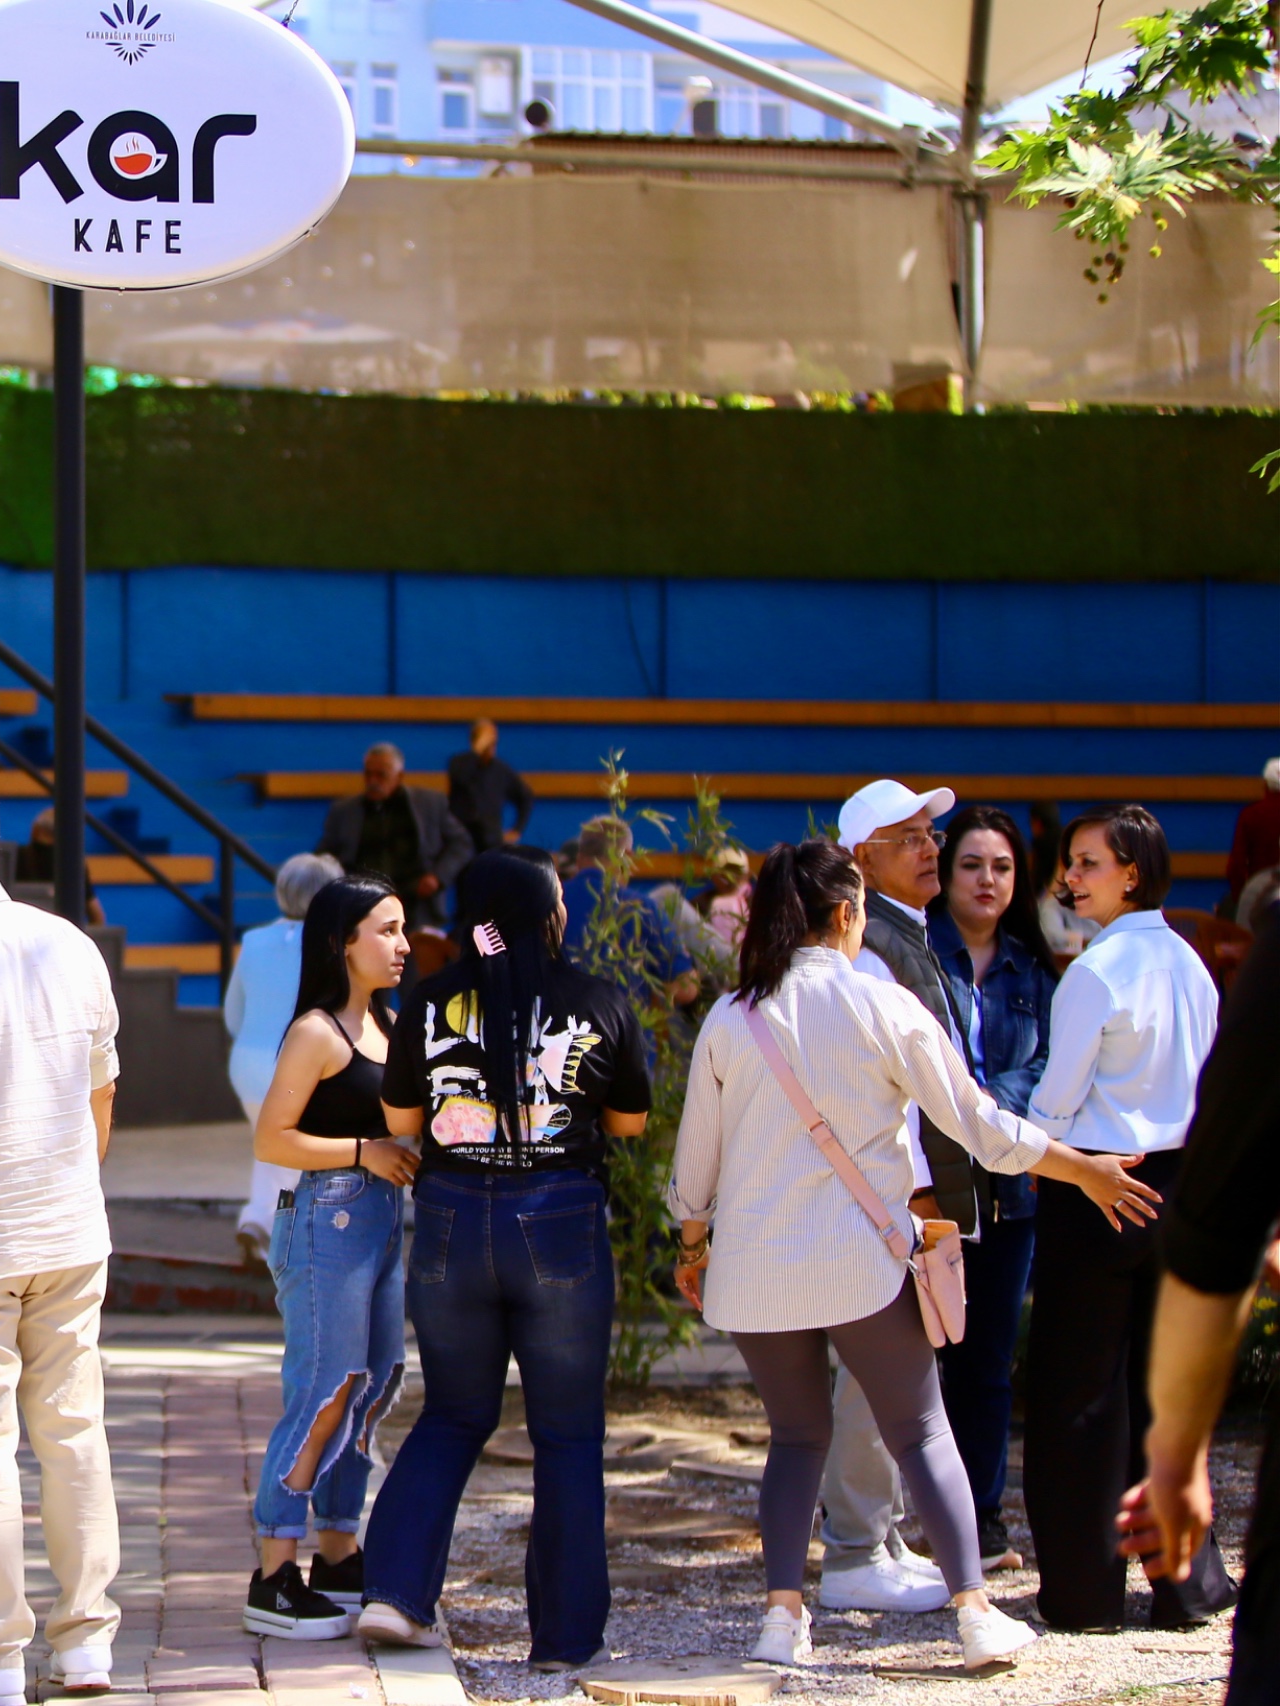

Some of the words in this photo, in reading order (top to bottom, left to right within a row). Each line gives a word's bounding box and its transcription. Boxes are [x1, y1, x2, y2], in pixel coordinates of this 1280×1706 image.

[86, 31, 132, 40] KARABAĞLAR
[135, 32, 175, 42] BELEDİYESİ
[74, 218, 182, 254] KAFE
[475, 1146, 490, 1154] YOU
[535, 1146, 565, 1154] PERSON
[480, 1156, 491, 1164] BE
